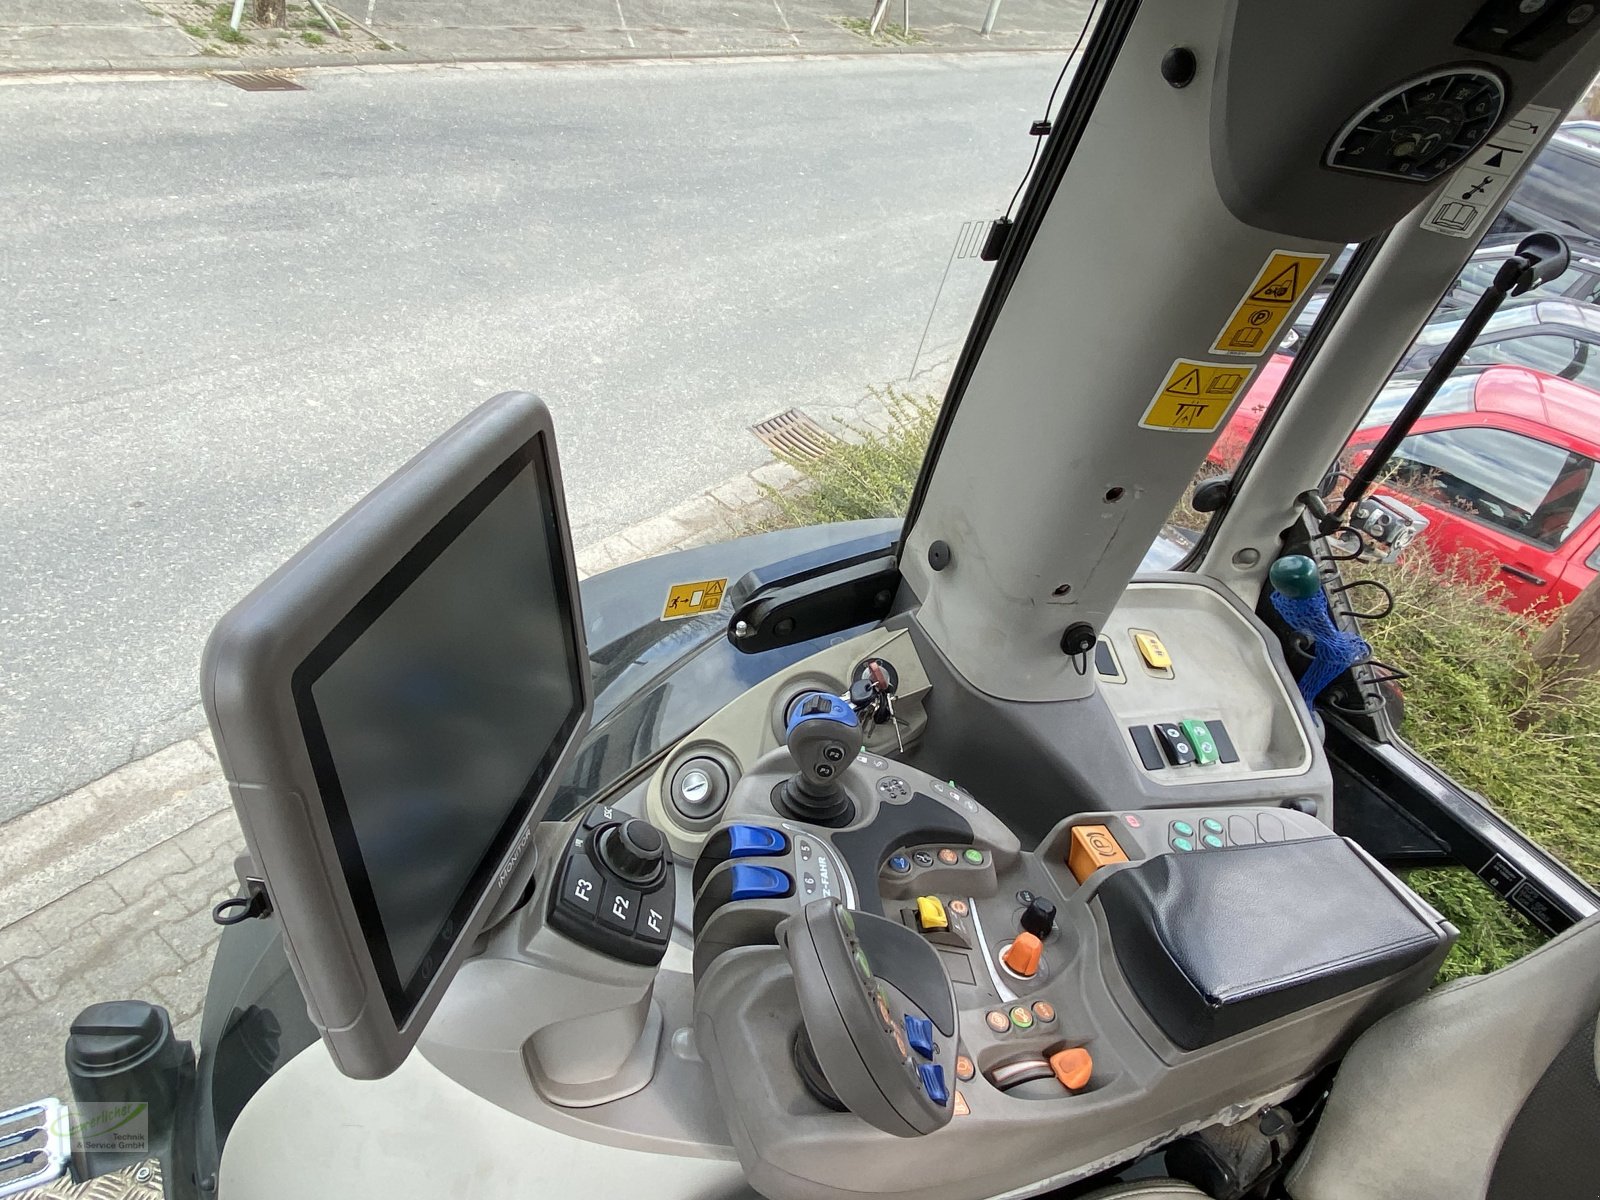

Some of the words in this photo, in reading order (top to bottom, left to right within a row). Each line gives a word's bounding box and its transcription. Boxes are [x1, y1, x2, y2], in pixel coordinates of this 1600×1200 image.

[818, 856, 832, 898] Z-FAHR
[575, 878, 593, 902] F3
[612, 895, 630, 920] F2
[647, 908, 663, 933] F1
